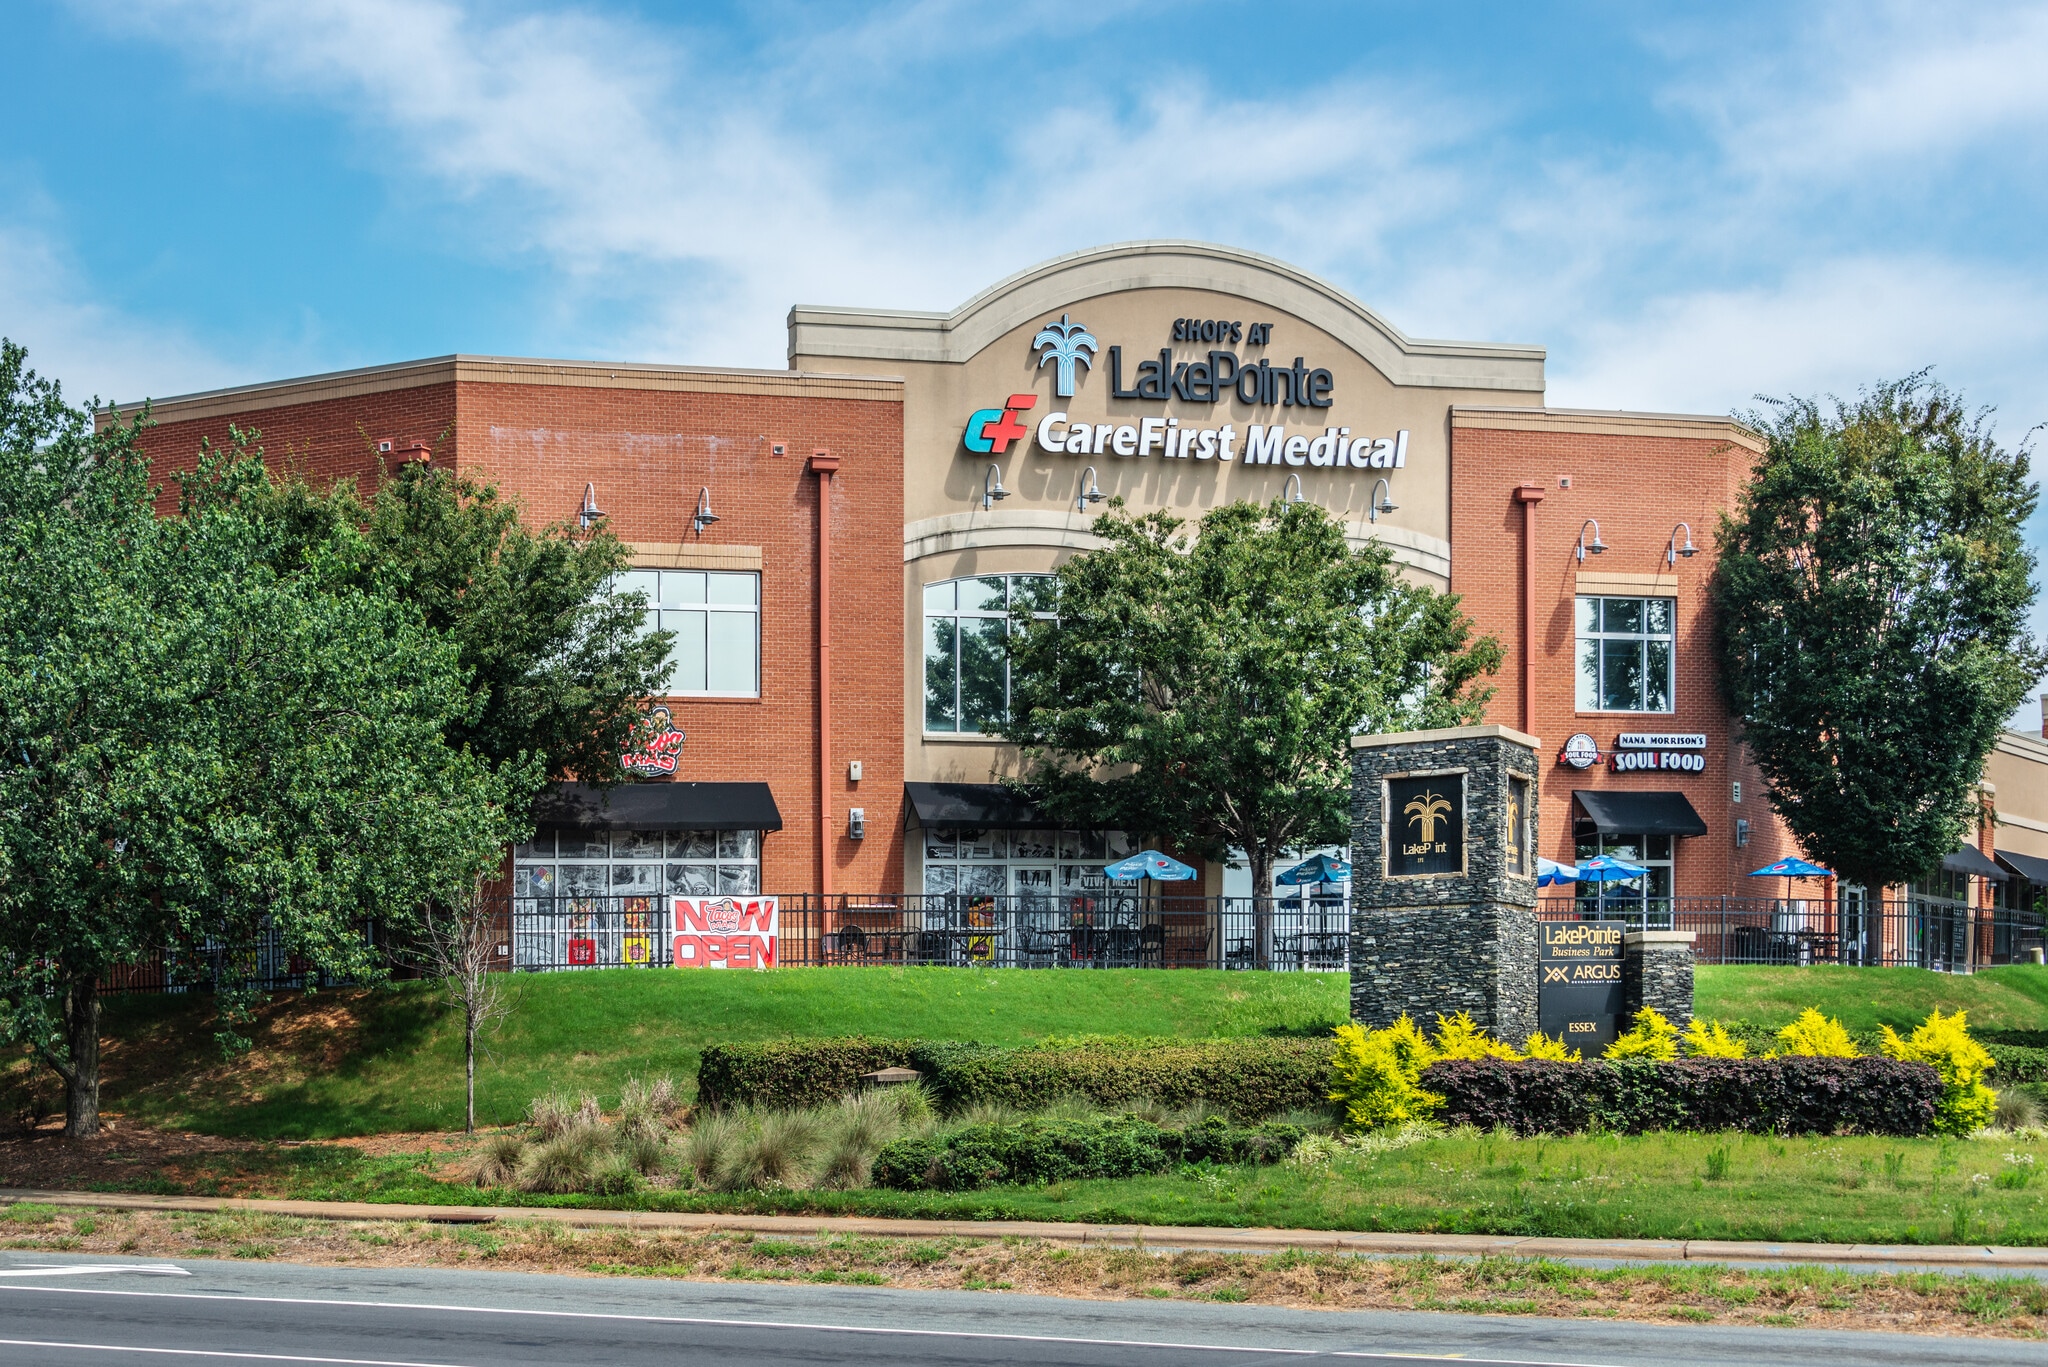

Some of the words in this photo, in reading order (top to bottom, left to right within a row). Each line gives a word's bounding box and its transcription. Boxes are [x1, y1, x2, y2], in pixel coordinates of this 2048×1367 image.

[1174, 318, 1242, 344] SHOPS
[1248, 322, 1274, 345] AT
[1110, 345, 1334, 407] LakePointe
[1038, 411, 1236, 461] CareFirst
[1244, 424, 1410, 469] Medical
[1622, 736, 1646, 744] NANA
[1650, 736, 1703, 745] MORRISON'S
[1565, 751, 1580, 759] SOUL
[1615, 752, 1657, 771] SOUL
[1661, 752, 1705, 771] FOOD
[675, 900, 774, 931] NW
[707, 906, 739, 921] Tacos
[1545, 925, 1621, 944] LakePointe
[673, 934, 777, 968] OPEN
[1552, 946, 1591, 957] Business
[1593, 946, 1615, 957] Park
[1573, 964, 1621, 980] ARGUS
[1568, 1023, 1597, 1032] ESSEX
